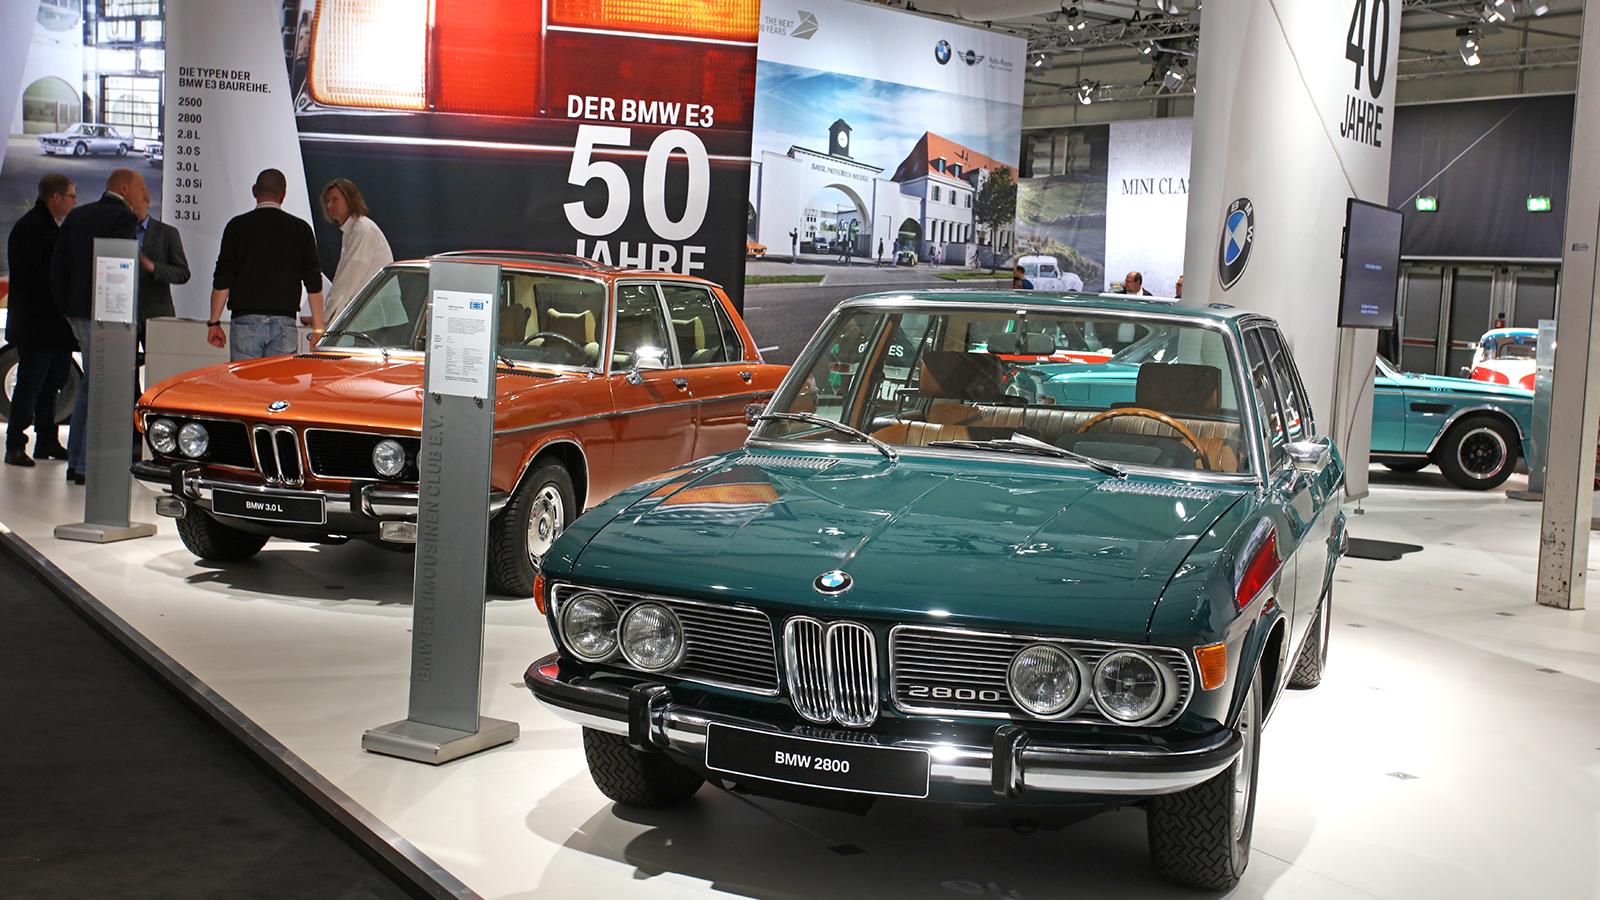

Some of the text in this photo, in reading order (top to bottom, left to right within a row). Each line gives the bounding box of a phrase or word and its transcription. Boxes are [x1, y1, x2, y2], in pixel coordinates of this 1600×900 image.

[765, 16, 794, 29] THE NEXT
[766, 25, 787, 36] YEARS
[1345, 0, 1390, 99] 40
[179, 66, 251, 80] DIE TYPEN DER
[179, 78, 271, 93] BMW E3 BAUREIHE.
[178, 97, 203, 107] 2500
[178, 113, 202, 123] 2800
[567, 95, 714, 128] DER BMW E3
[1340, 94, 1384, 148] JAHRE
[177, 129, 200, 139] 2.8 L
[177, 145, 200, 156] 3.0 S
[176, 162, 199, 172] 3.0 L
[176, 178, 203, 188] 3.0 Si
[563, 124, 710, 241] 50
[1122, 178, 1188, 195] MINI CLA
[175, 194, 198, 204] 3.3 L
[175, 210, 200, 220] 3.3 Li
[429, 414, 444, 447] E.V.
[427, 451, 443, 497] CLUB
[245, 501, 283, 512] BMW 3.0 L
[422, 501, 440, 611] LIMOUSINEN
[909, 685, 1000, 701] 2800
[775, 751, 849, 773] BMW 2800
